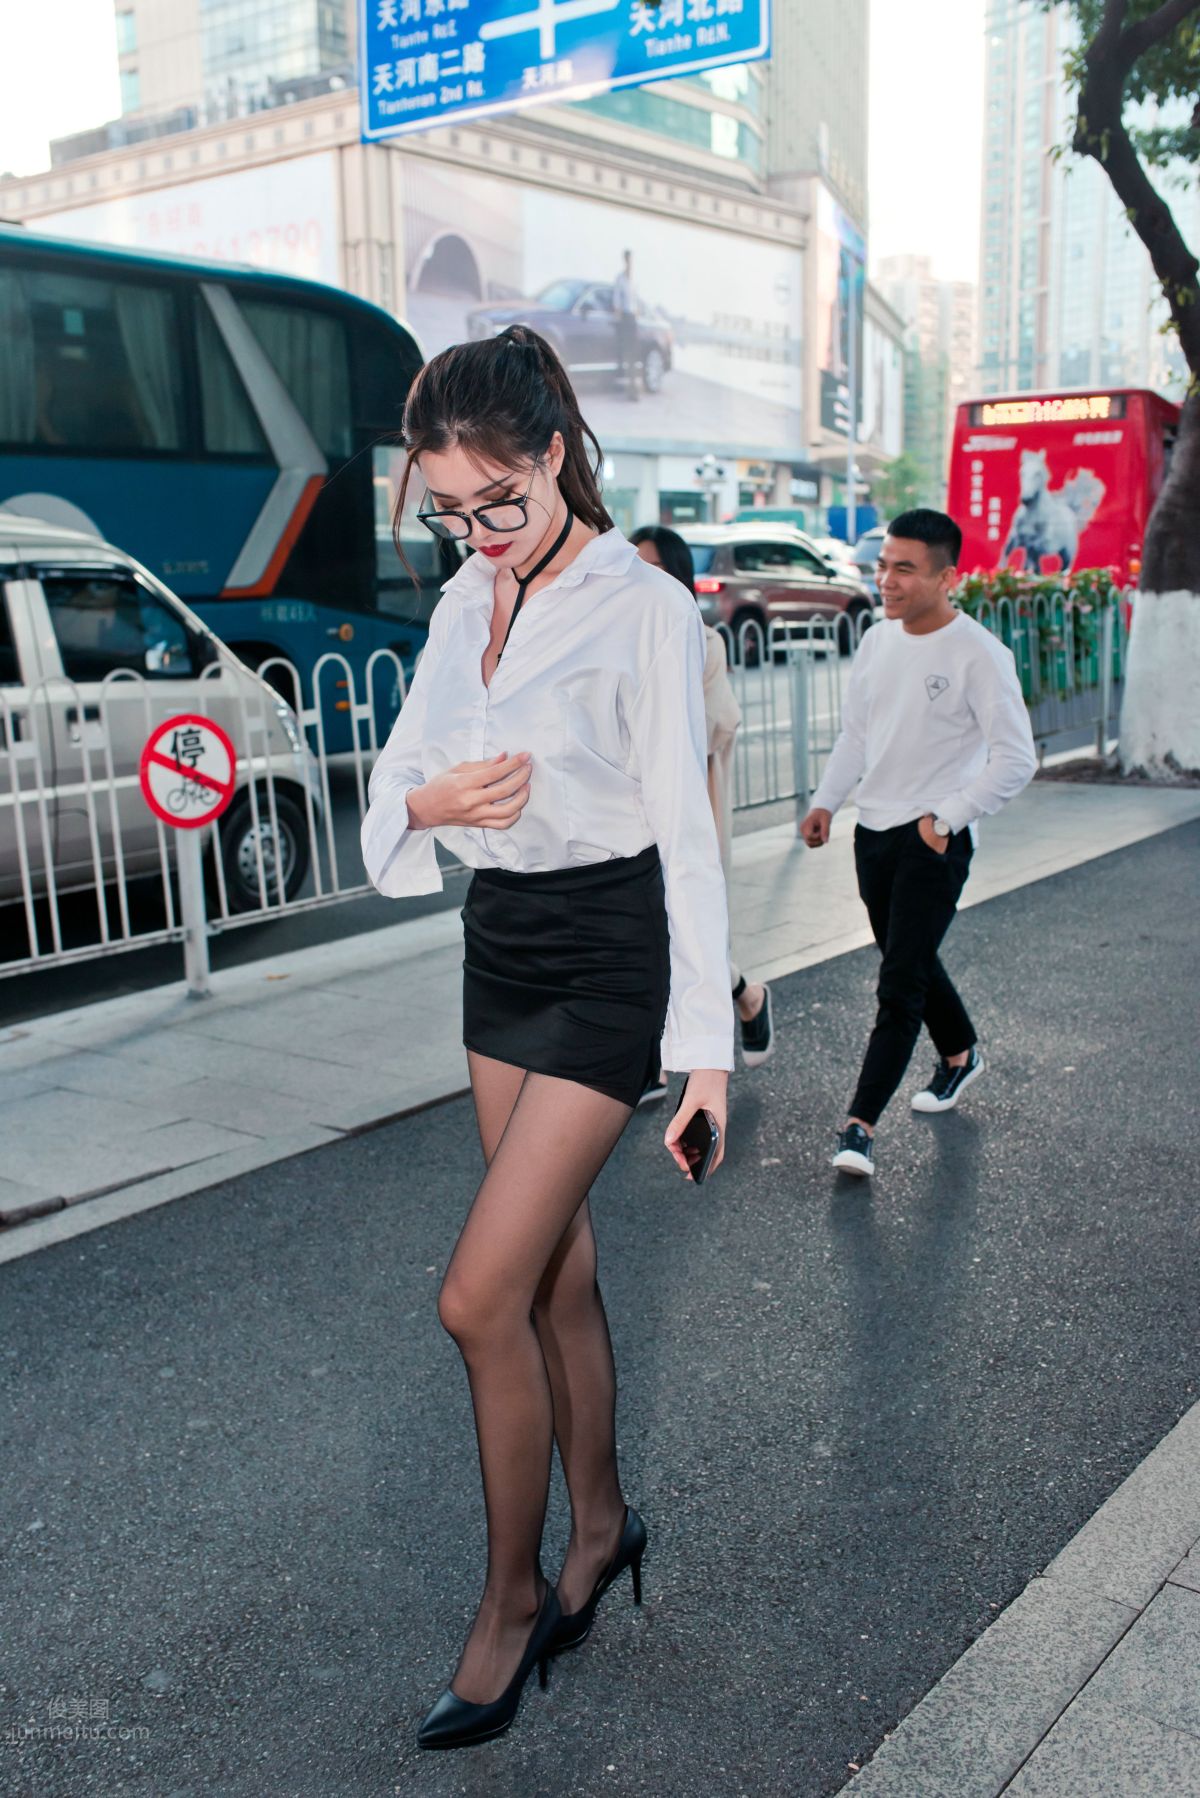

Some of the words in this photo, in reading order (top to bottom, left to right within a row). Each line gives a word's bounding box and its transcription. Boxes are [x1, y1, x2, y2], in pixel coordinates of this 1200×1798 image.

[645, 33, 692, 58] Tianhe
[372, 41, 486, 96] 天河南二路
[440, 84, 463, 104] 2nd
[171, 728, 205, 770] 停
